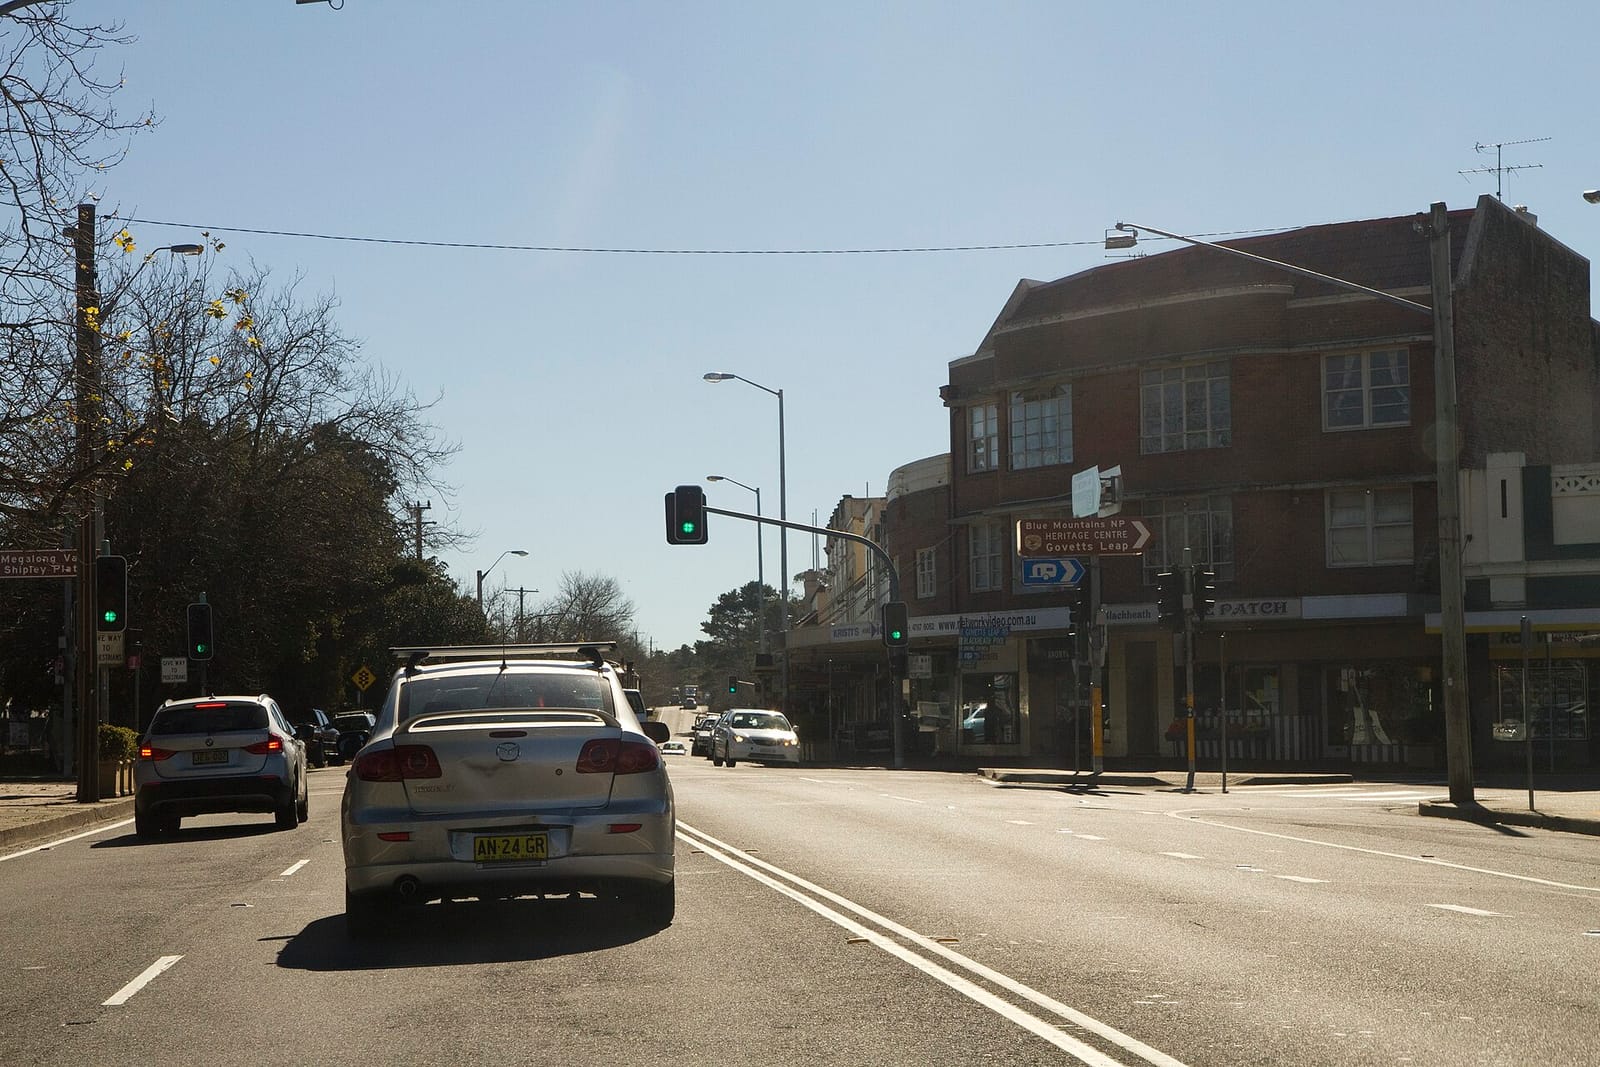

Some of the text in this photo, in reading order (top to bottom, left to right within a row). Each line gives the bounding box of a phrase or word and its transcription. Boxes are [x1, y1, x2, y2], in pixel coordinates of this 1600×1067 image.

[1025, 519, 1126, 530] Blue Mountains NP
[1045, 530, 1128, 541] HERITAGE CENTRE
[1046, 541, 1129, 552] Govetts Leap
[1, 554, 56, 565] Megalong
[4, 564, 77, 575] Shipley Plat
[1220, 601, 1289, 616] PATCH
[526, 837, 545, 853] GR
